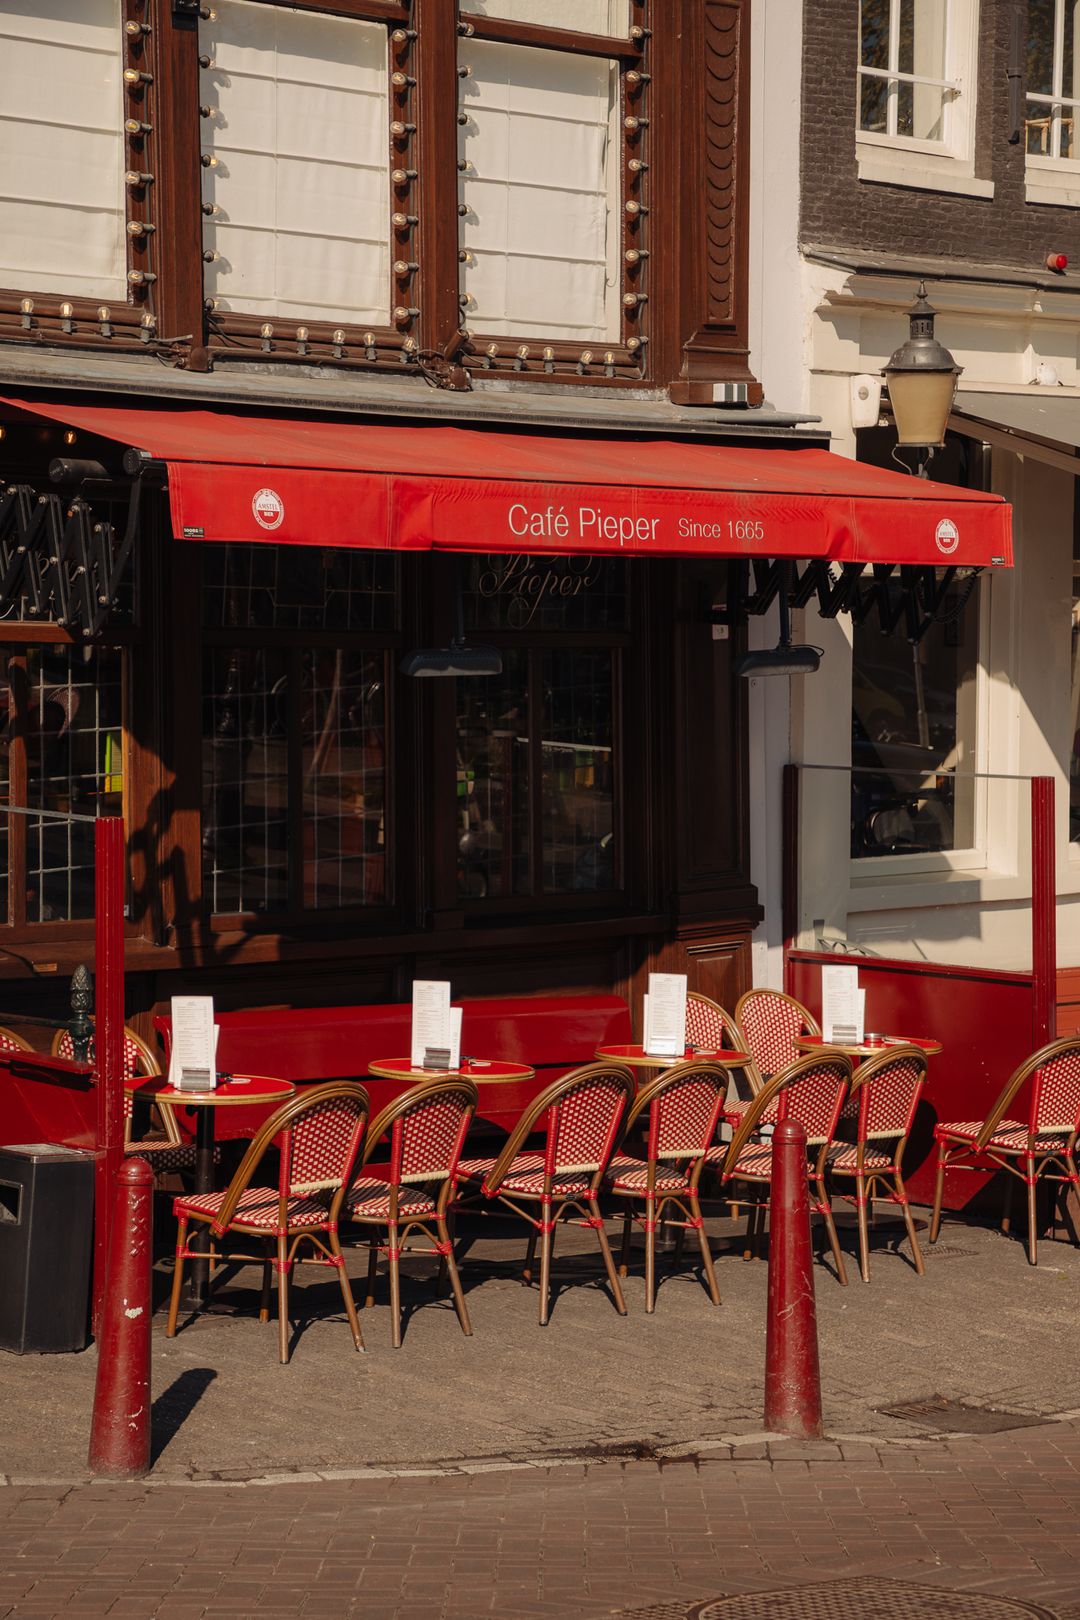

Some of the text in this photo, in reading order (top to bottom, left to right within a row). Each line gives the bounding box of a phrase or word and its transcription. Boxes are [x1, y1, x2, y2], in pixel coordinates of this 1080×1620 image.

[508, 503, 660, 546] Café Pieper
[678, 517, 764, 540] Since 1665
